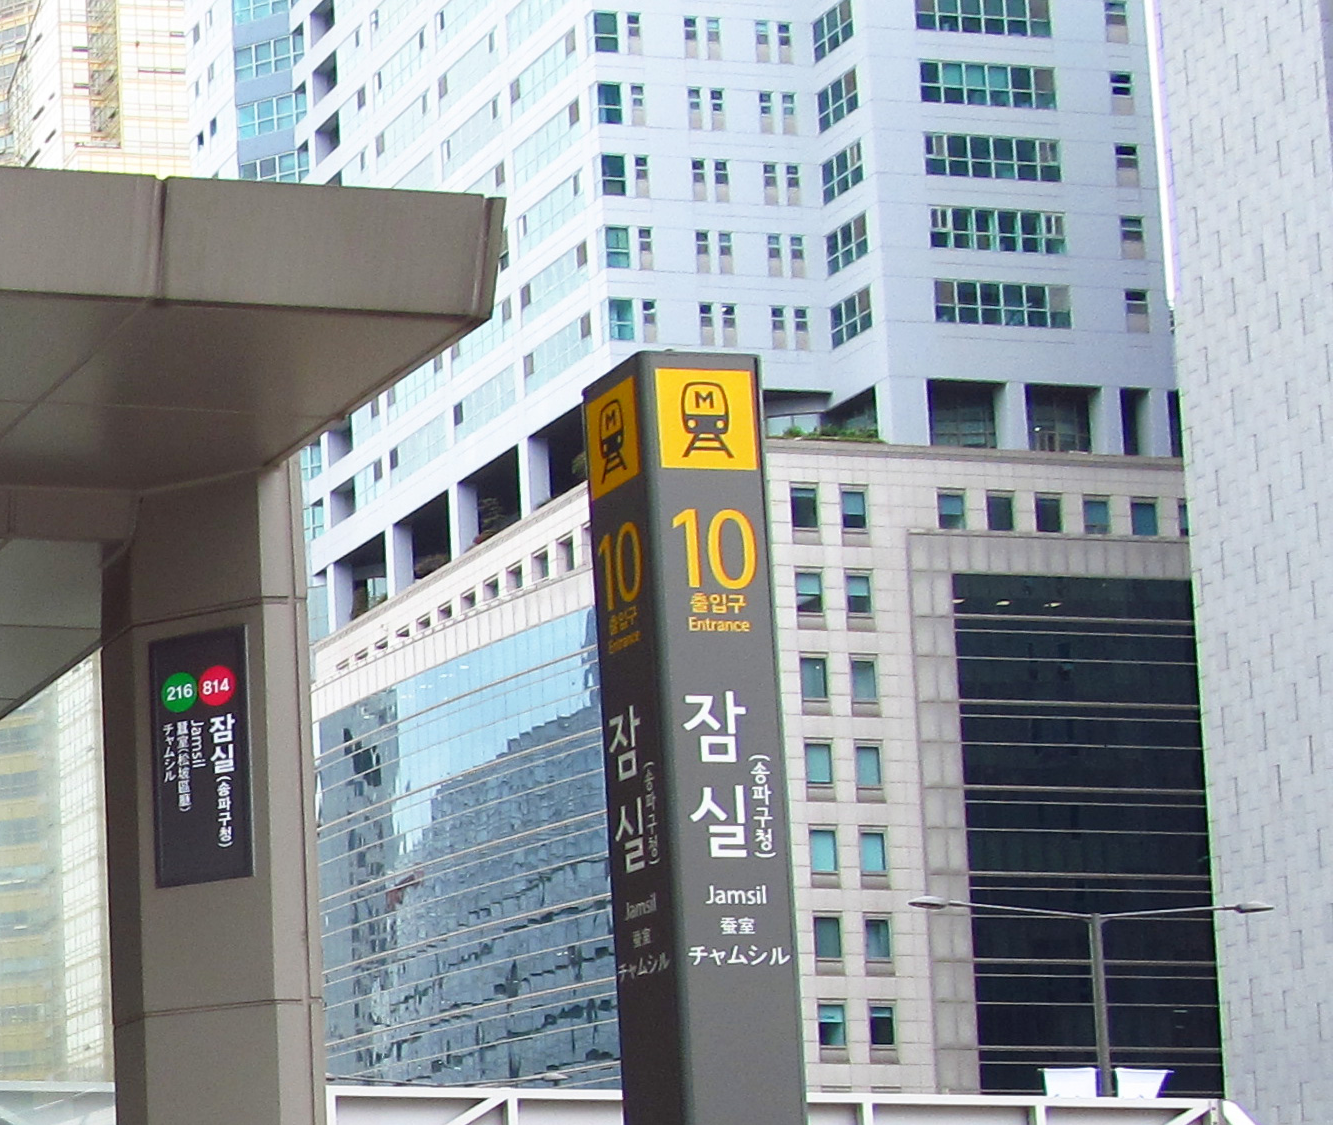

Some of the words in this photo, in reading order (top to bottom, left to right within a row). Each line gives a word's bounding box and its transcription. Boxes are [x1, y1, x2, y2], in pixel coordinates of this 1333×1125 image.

[694, 390, 715, 409] M
[672, 508, 758, 590] 10
[598, 521, 644, 612] 10
[690, 592, 747, 614] 출입구
[688, 617, 751, 633] Entrance
[166, 683, 193, 701] 216
[202, 678, 230, 695] 814
[162, 723, 177, 783] チャムシル
[190, 719, 207, 768] Jamsil
[682, 690, 748, 859] 잠실
[609, 705, 646, 874] 잠실
[642, 761, 660, 865] (송파구청)
[748, 753, 776, 859] (송파구청)
[624, 892, 657, 921] Jamsil
[705, 885, 768, 906] Jamsil
[720, 916, 756, 935] 蚕室
[618, 952, 670, 982] チャムシル
[688, 944, 791, 967] チャムシル
